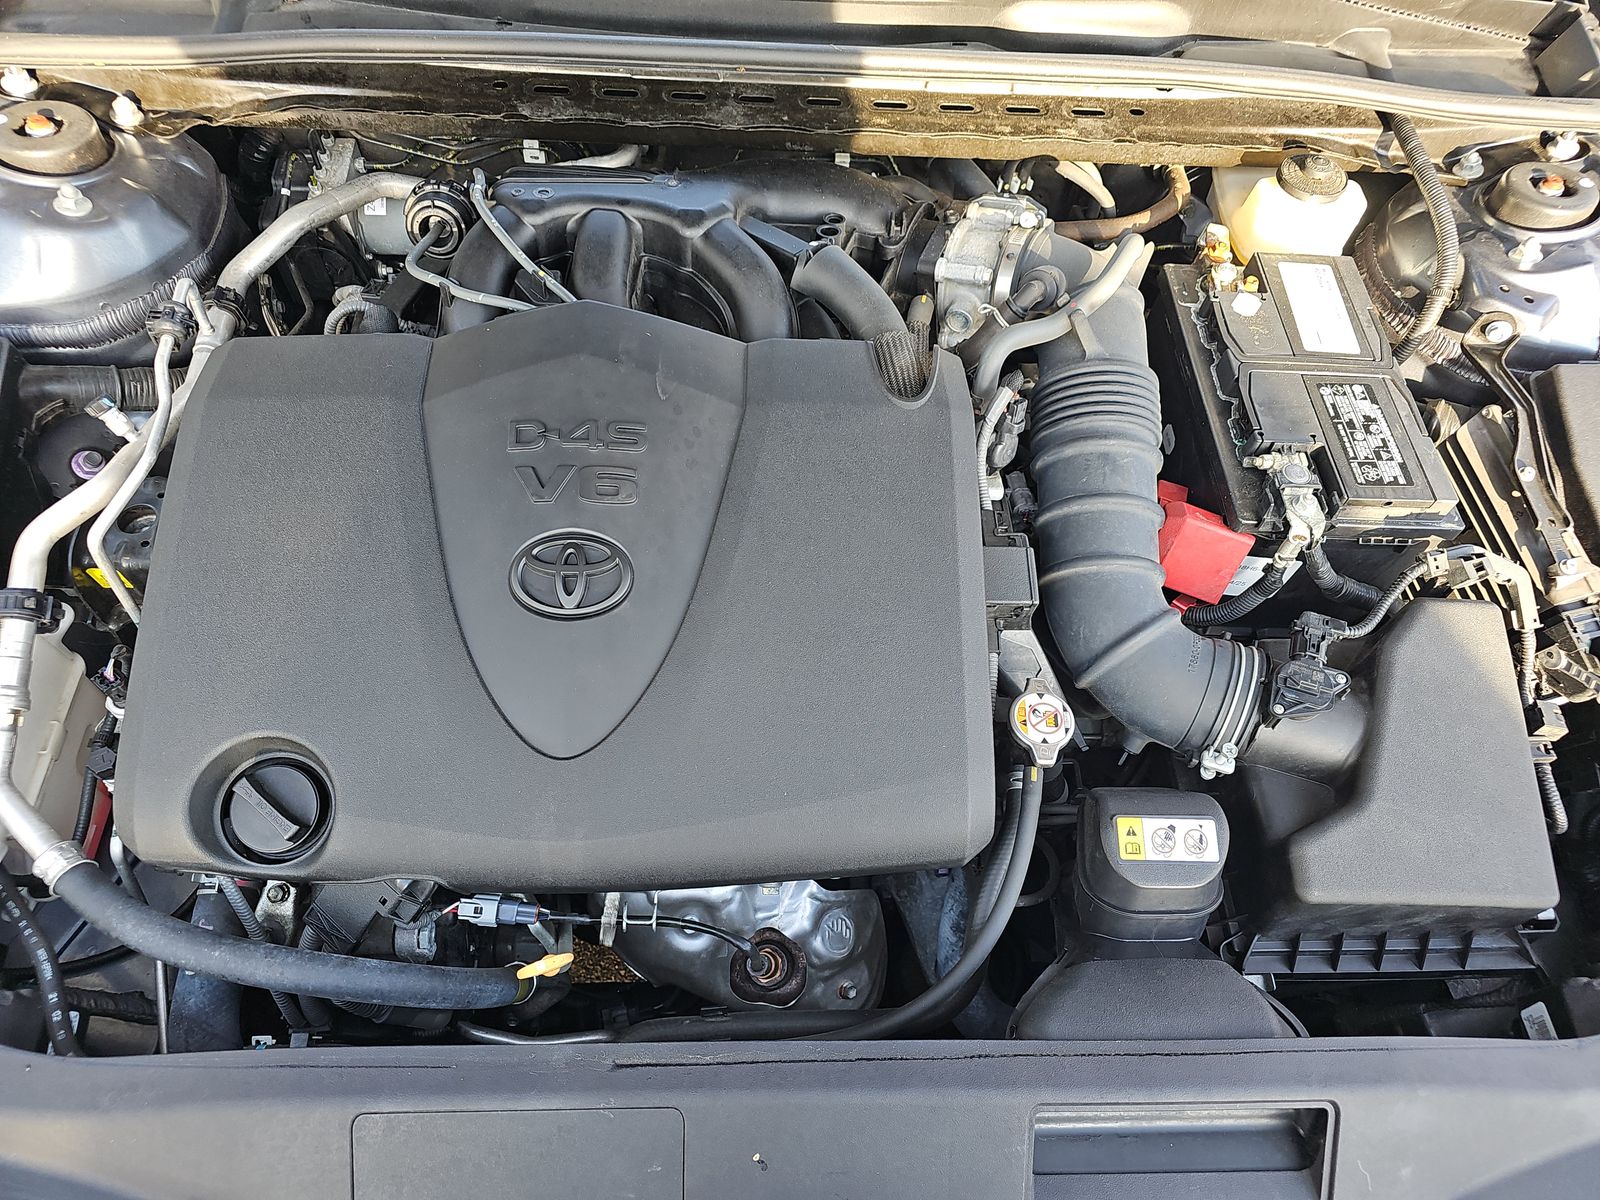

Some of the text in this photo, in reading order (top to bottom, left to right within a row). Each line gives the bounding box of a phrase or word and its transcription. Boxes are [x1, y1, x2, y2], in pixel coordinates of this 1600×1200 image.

[506, 419, 648, 453] D-4S
[512, 464, 638, 506] V6
[256, 797, 292, 832] ENGINE OIL
